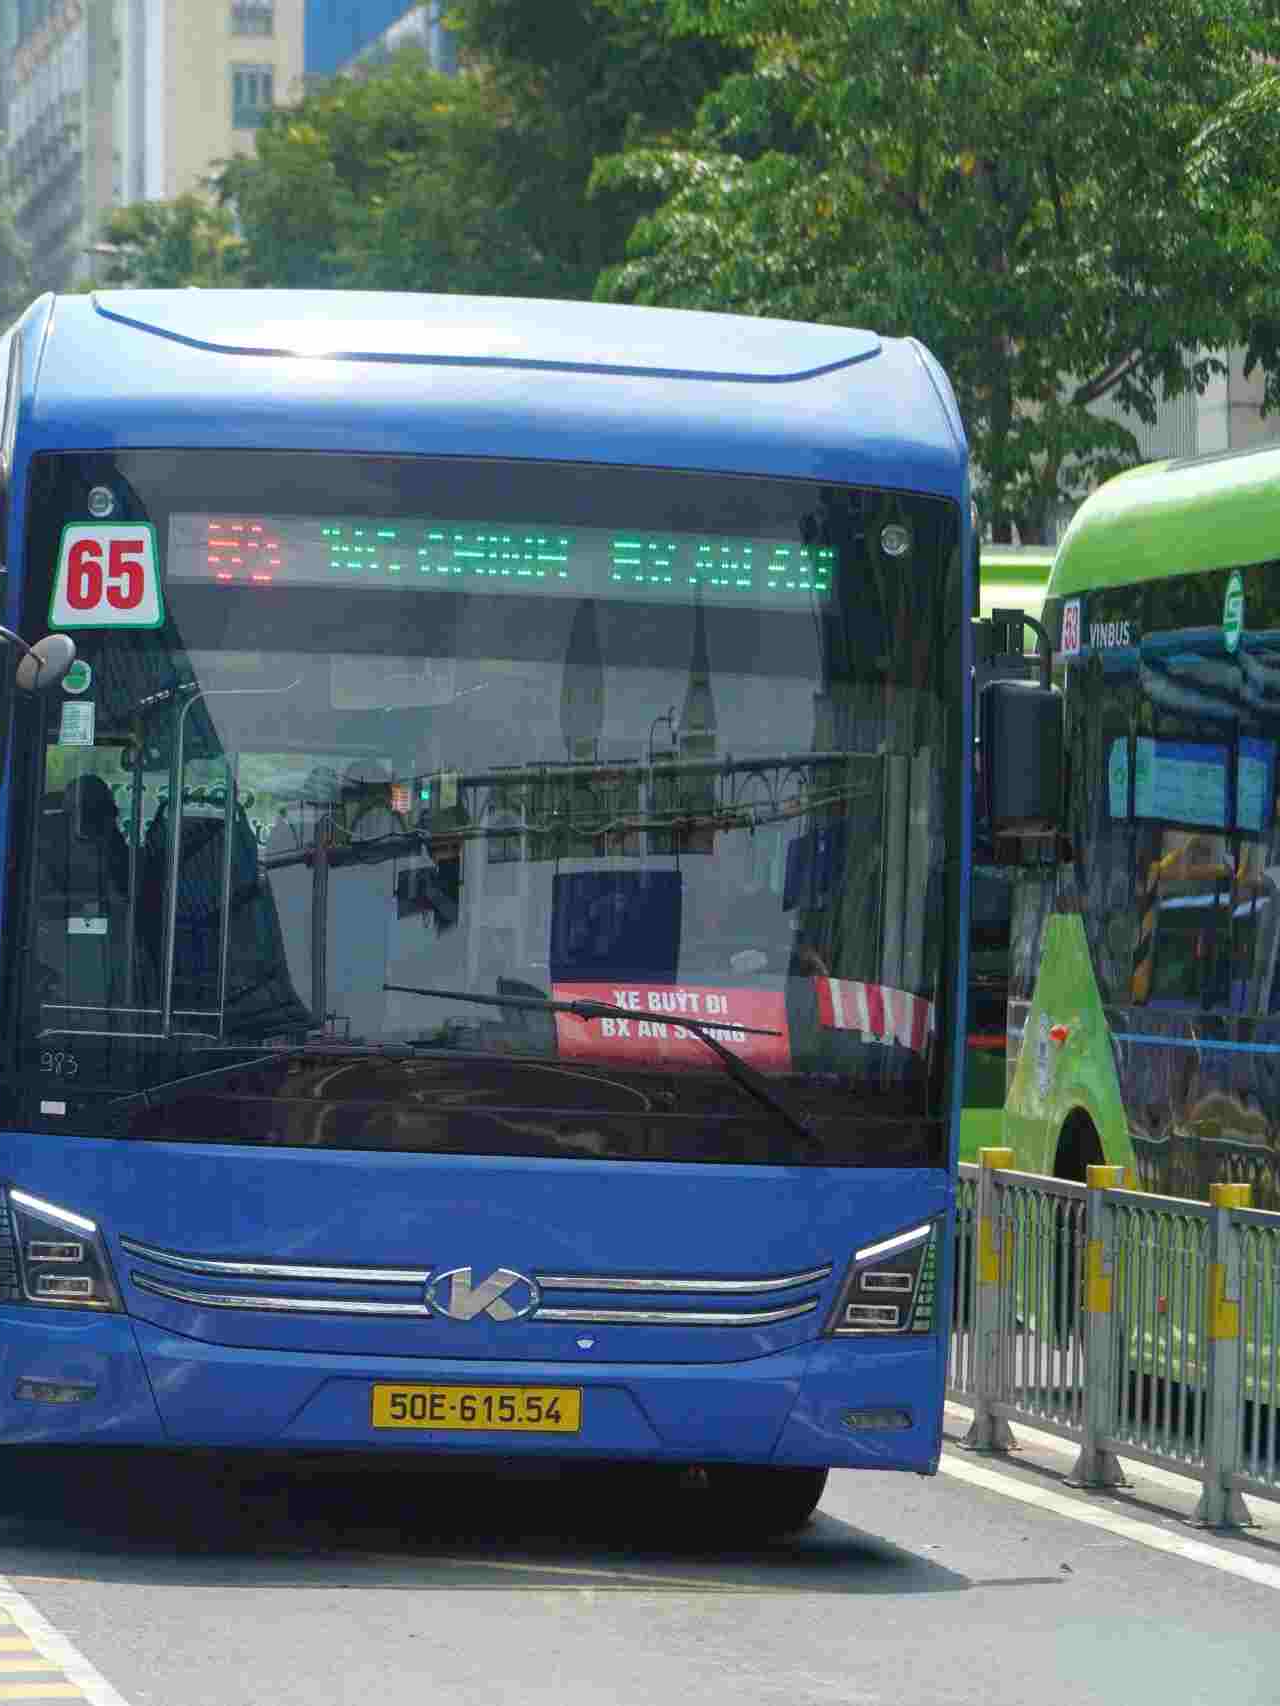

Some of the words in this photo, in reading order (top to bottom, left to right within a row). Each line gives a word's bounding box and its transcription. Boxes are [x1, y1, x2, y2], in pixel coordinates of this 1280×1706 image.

[66, 539, 145, 609] 65
[1089, 619, 1130, 649] VINBUS
[614, 990, 641, 1011] XE
[601, 1017, 630, 1037] BX
[638, 1019, 668, 1039] AN
[390, 1392, 561, 1424] 50E-615.54
